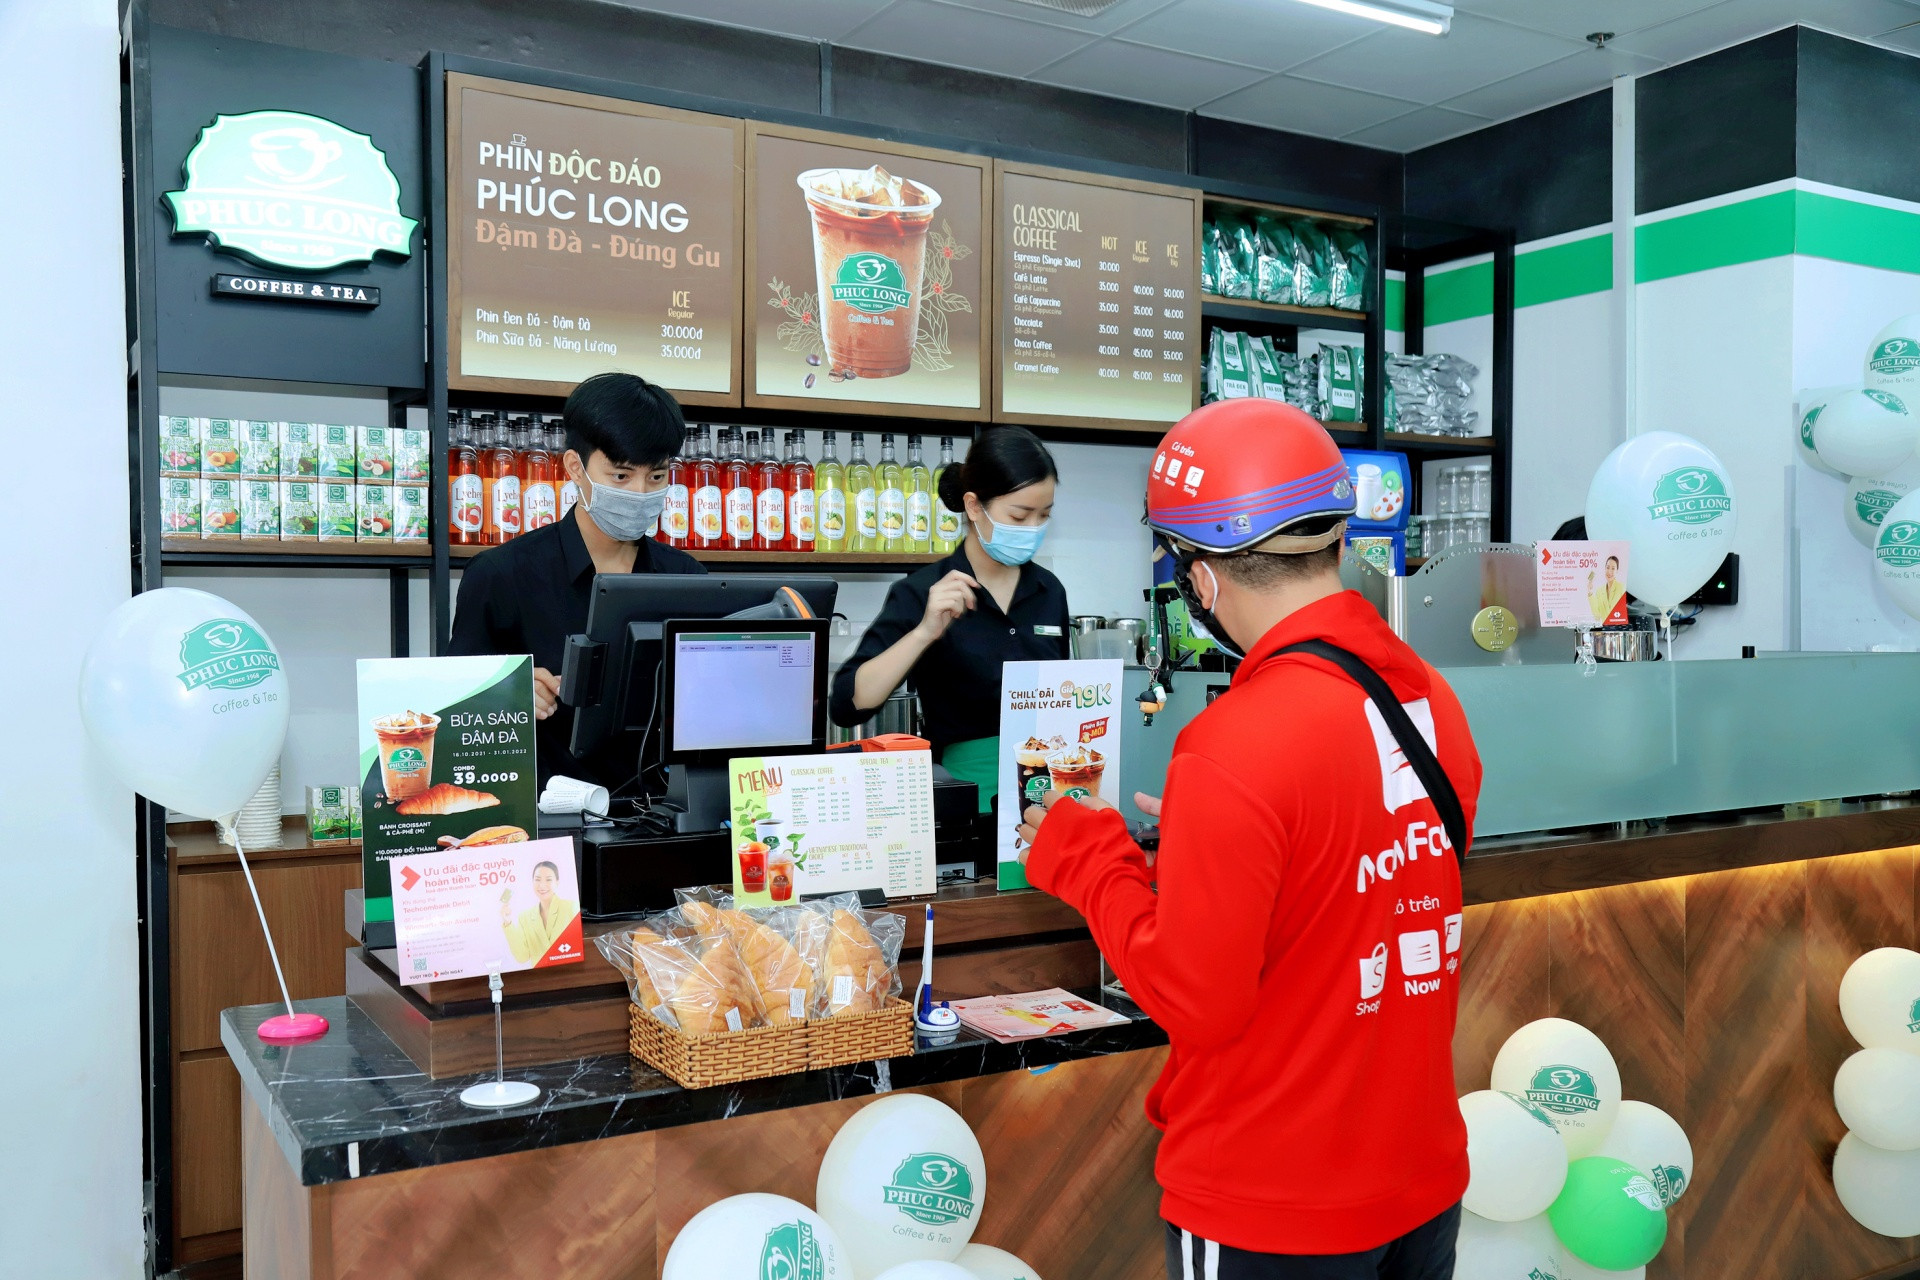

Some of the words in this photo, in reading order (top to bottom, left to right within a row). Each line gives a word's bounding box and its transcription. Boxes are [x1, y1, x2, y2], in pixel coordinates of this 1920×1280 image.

[479, 141, 543, 174] PHIN
[548, 149, 602, 184] ĐỘC
[608, 157, 661, 189] ĐÁO
[477, 175, 577, 220] PHÚC
[588, 193, 689, 233] LONG
[184, 199, 293, 228] PHUC
[302, 204, 404, 246] LONG
[1013, 203, 1083, 233] CLASSICAL
[475, 218, 538, 252] Đậm
[547, 226, 582, 254] Đà
[609, 234, 677, 269] Đúng
[686, 243, 720, 268] Gu
[1013, 225, 1058, 251] COFFEE
[1101, 236, 1118, 251] HOT
[1135, 240, 1147, 255] ICE
[1166, 244, 1179, 259] ICE
[1013, 251, 1040, 264] Espresso
[1064, 256, 1081, 270] Shot)
[1098, 261, 1120, 273] 30.000
[229, 278, 304, 296] COFFEE
[310, 285, 325, 297] &
[330, 286, 368, 302] TEA
[835, 287, 870, 299] PHUC
[872, 287, 906, 304] LONG
[1029, 273, 1048, 285] Latte
[1098, 281, 1119, 292] 35.000
[1133, 284, 1154, 296] 40.000
[1163, 287, 1185, 299] 50.000
[672, 290, 691, 309] ICE
[1029, 294, 1061, 308] Cappuccino
[1098, 301, 1119, 313] 35.000
[1133, 305, 1154, 317] 35.000
[667, 307, 695, 320] Regular
[476, 308, 499, 324] Phin
[503, 311, 523, 325] Đen
[526, 312, 540, 327] Đá
[553, 314, 574, 332] Đậm
[578, 316, 591, 332] Đà
[660, 324, 704, 341] 30.000đ
[1013, 316, 1044, 328] Chocolate
[1098, 324, 1119, 336] 35.000
[1133, 327, 1154, 339] 40.000
[1163, 329, 1185, 341] 50.000
[476, 329, 499, 345] Phin
[502, 331, 525, 347] Sữa
[528, 333, 542, 348] Đá
[553, 335, 581, 354] Năng
[584, 337, 618, 356] Lượng
[660, 344, 702, 360] 35.000đ
[1014, 337, 1032, 349] Choco
[1032, 339, 1053, 351] Coffee
[1098, 345, 1120, 356] 40.000
[1163, 350, 1184, 362] 55.000
[1014, 361, 1039, 373] Caramel
[1039, 363, 1060, 374] Coffee
[1098, 368, 1120, 379] 40.000
[1163, 372, 1183, 383] 55.000
[1171, 441, 1182, 452] Có
[1180, 445, 1195, 458] trên
[527, 496, 555, 511] Lychee
[1652, 500, 1696, 517] PHUC
[1699, 498, 1730, 509] LONG
[1667, 530, 1698, 541] Coffee
[1710, 528, 1723, 537] Tea
[1877, 547, 1899, 558] PHUC
[1579, 558, 1598, 569] 50%
[184, 657, 239, 687] PHUC
[241, 654, 277, 668] LONG
[228, 676, 246, 685] Since
[246, 672, 260, 680] 1968
[212, 698, 250, 715] Coffee
[252, 693, 260, 705] &
[262, 691, 278, 703] Tea
[1010, 699, 1037, 710] NGÀN
[1038, 700, 1048, 709] LY
[1050, 699, 1072, 709] CAFE
[1039, 687, 1054, 699] ĐÃI
[1072, 682, 1113, 709] 19K
[451, 712, 484, 728] BỮA
[487, 709, 528, 725] SÁNG
[461, 731, 495, 747] ĐẬM
[498, 727, 519, 744] ĐÀ
[453, 771, 519, 785] 39.000Đ
[738, 766, 783, 794] MENU
[397, 821, 432, 829] CROISSANT
[423, 867, 440, 877] Ưu
[442, 865, 459, 875] đãi
[461, 863, 481, 873] đặc
[483, 857, 515, 870] quyền
[424, 877, 449, 888] hoàn
[452, 874, 470, 885] tiền
[479, 869, 516, 886] 50%
[404, 903, 451, 914] Techcombank
[452, 900, 471, 908] Debit
[1408, 894, 1441, 914] trên
[1404, 977, 1441, 997] Now
[1355, 999, 1381, 1016] Shop
[1528, 1092, 1563, 1102] PHUC
[1565, 1095, 1597, 1109] LONG
[1654, 1168, 1669, 1197] PHUC
[887, 1190, 933, 1207] PHUC
[936, 1197, 971, 1216] LONG
[915, 1211, 932, 1219] Since
[892, 1224, 925, 1240] Coffee
[927, 1232, 935, 1242] &
[937, 1233, 952, 1244] Tea
[801, 1225, 812, 1271] LONG
